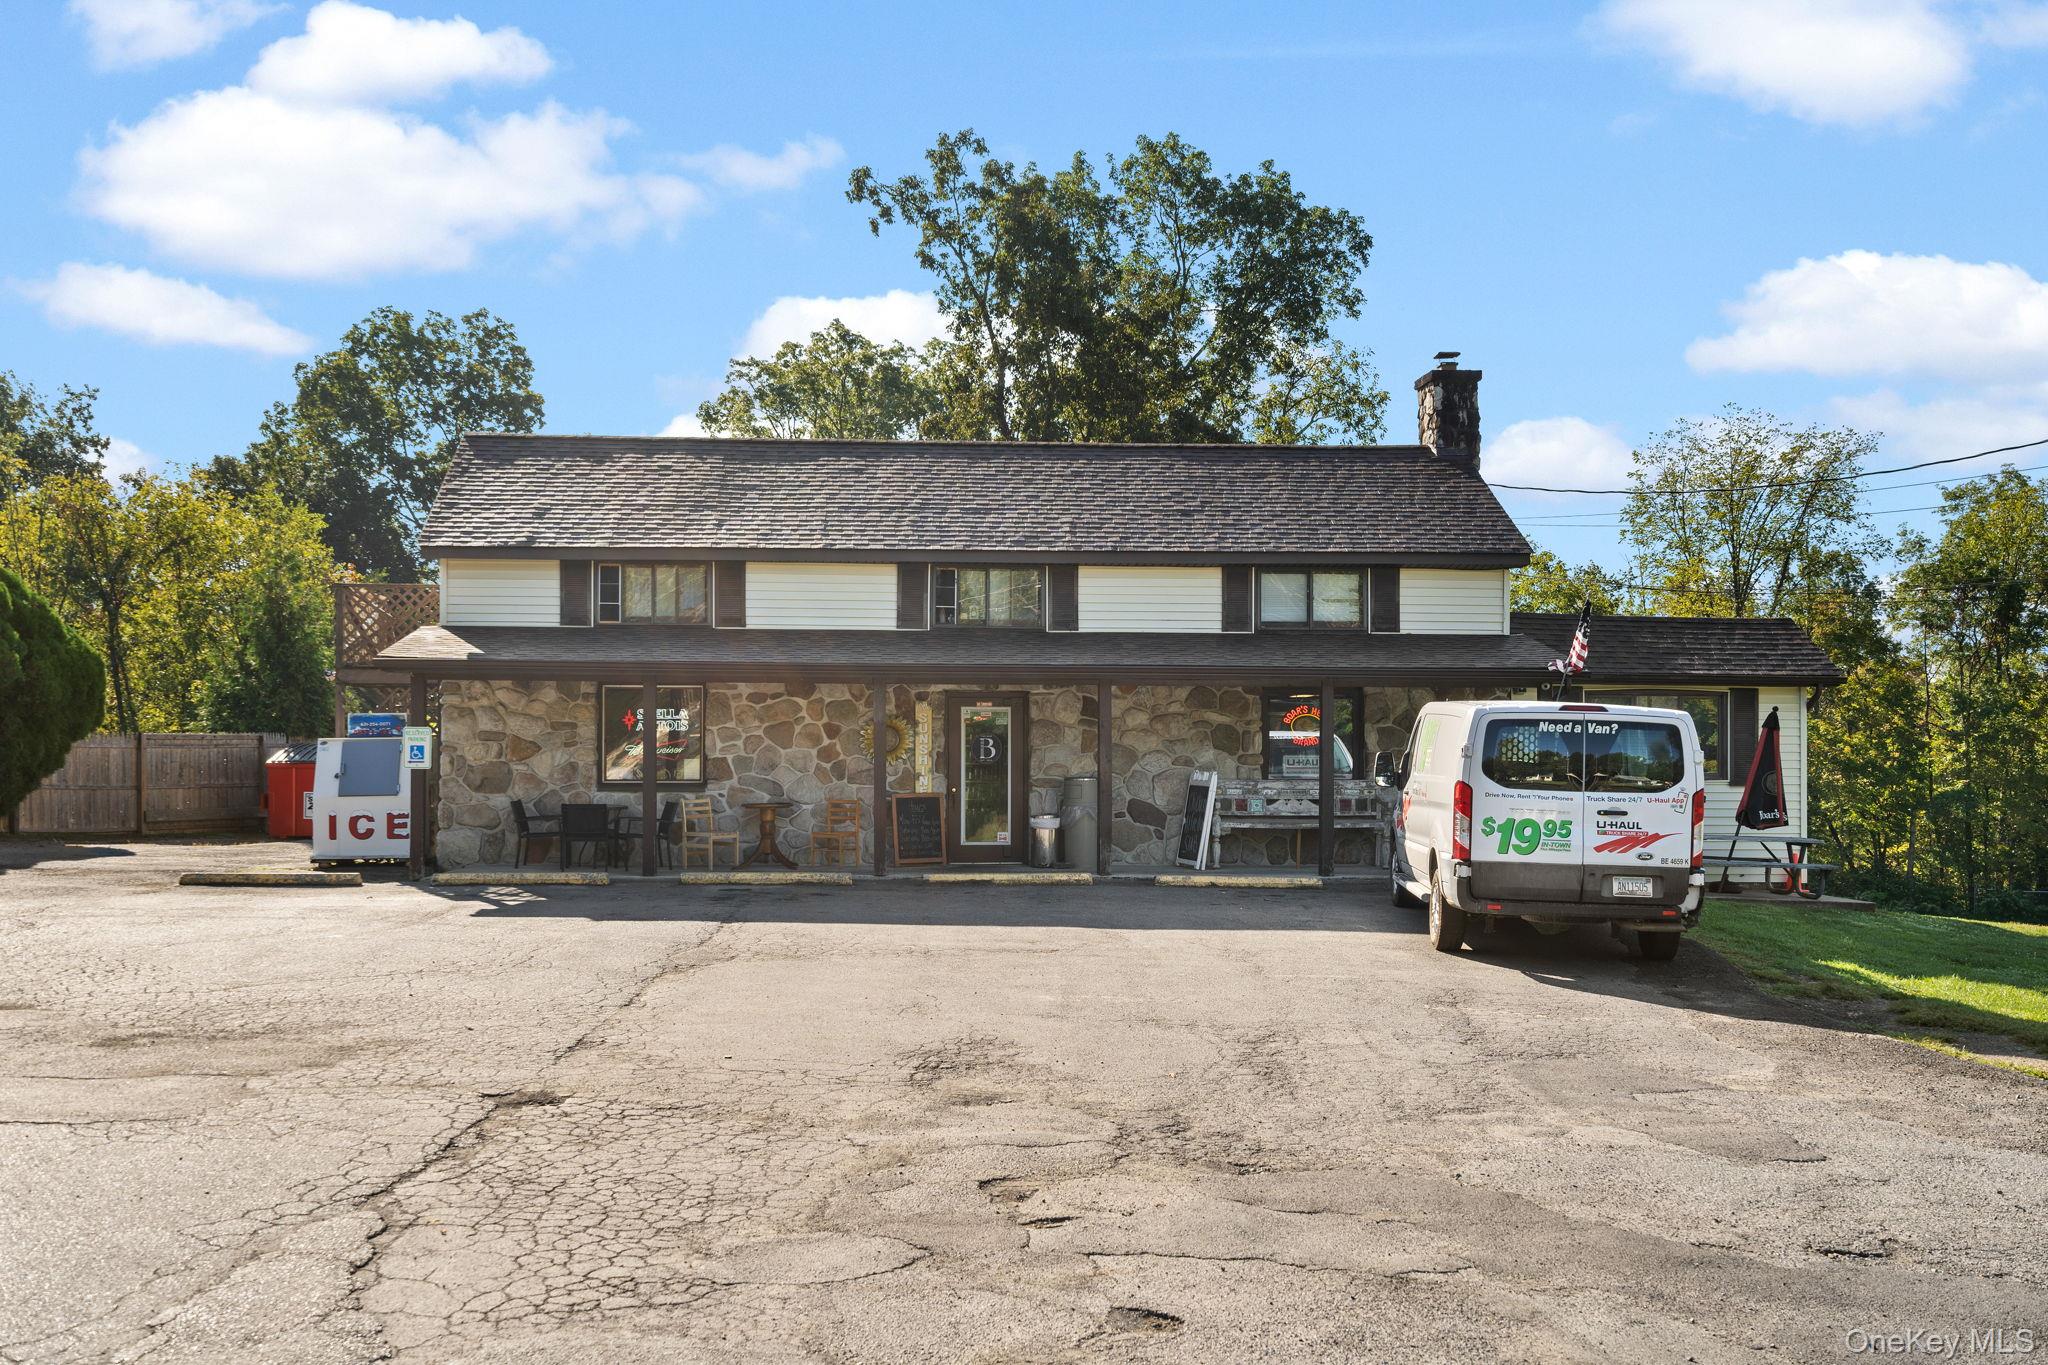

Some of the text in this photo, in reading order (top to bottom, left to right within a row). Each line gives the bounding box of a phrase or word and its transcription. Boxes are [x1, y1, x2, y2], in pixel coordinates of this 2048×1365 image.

[636, 708, 690, 719] SELLA
[1283, 705, 1309, 724] BOAR'S
[635, 720, 690, 731] ATOIS
[1538, 721, 1619, 735] Need a Van?
[979, 737, 996, 759] B
[1286, 758, 1319, 767] U-HAU
[1587, 795, 1606, 803] Truck
[1628, 796, 1643, 804] 24/7
[328, 810, 410, 840] ICE
[1596, 820, 1643, 830] U-HAUL
